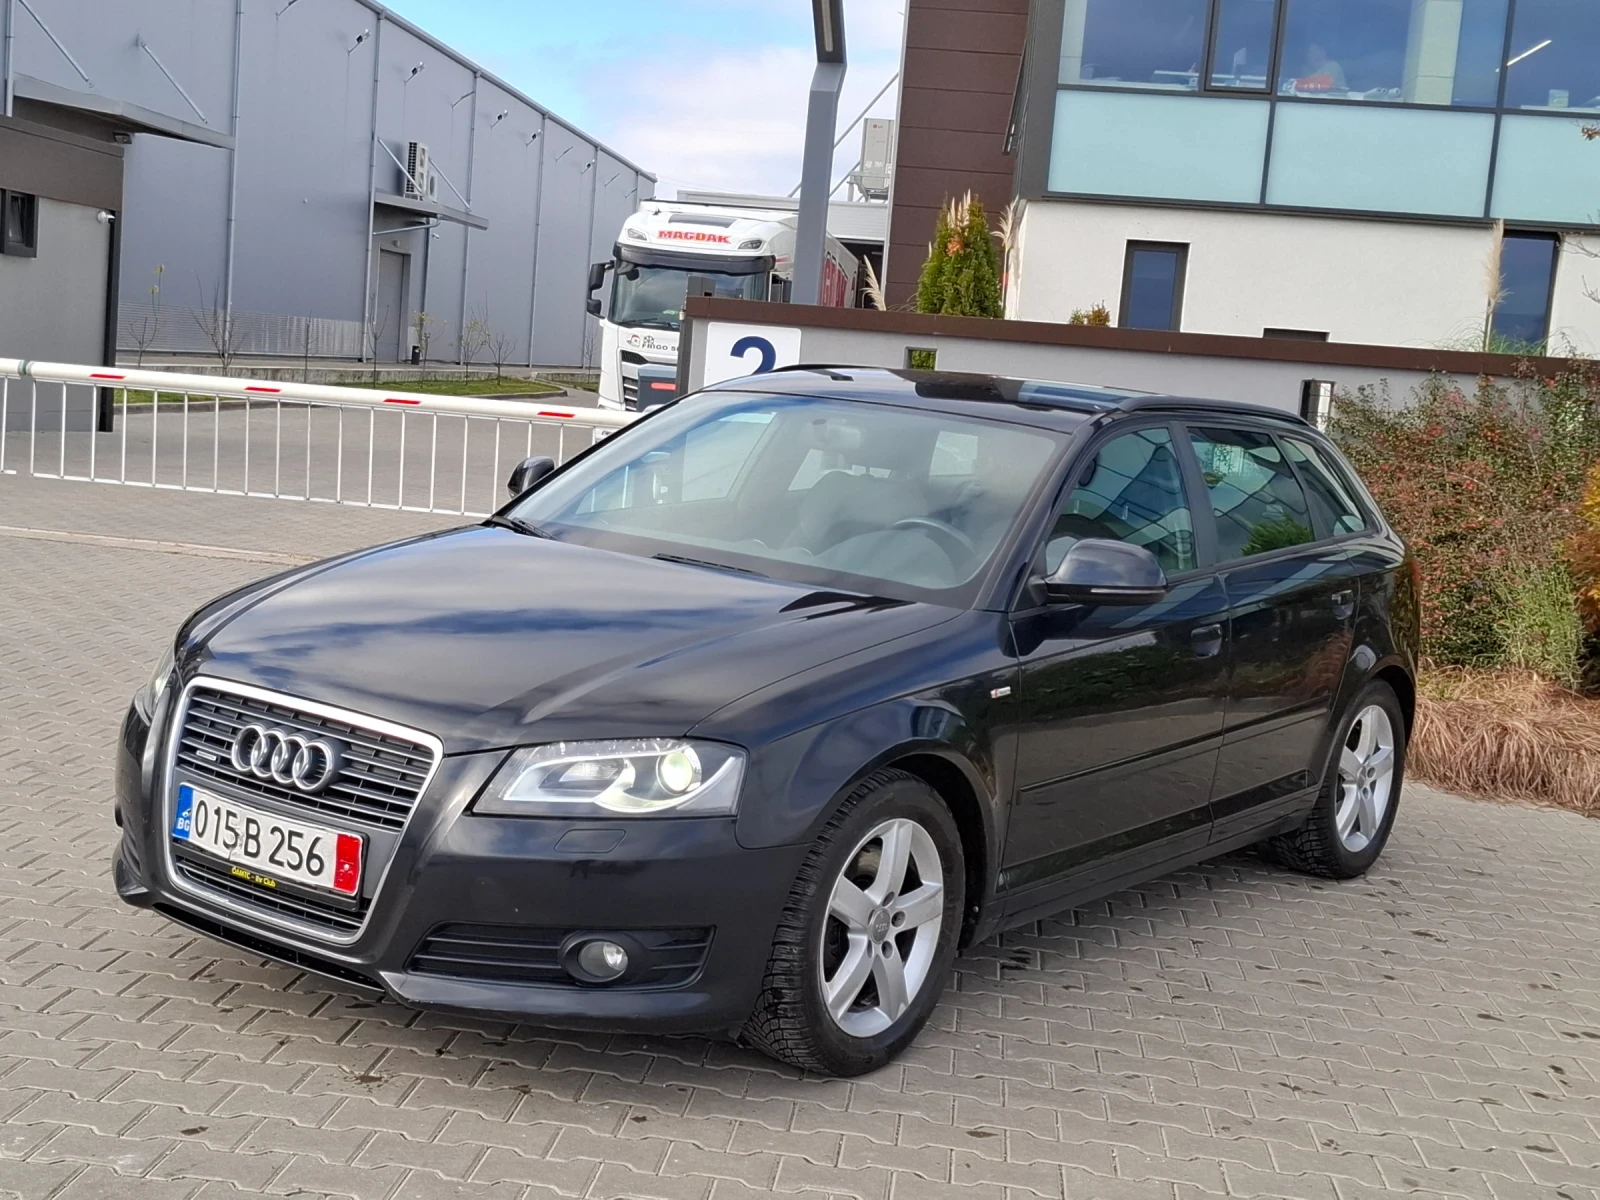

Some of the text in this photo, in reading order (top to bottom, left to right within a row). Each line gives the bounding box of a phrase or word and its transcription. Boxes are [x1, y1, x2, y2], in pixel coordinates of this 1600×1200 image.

[658, 230, 731, 244] MAGDAK
[642, 343, 668, 351] FRIGO
[730, 336, 777, 375] 2
[177, 818, 190, 832] BG
